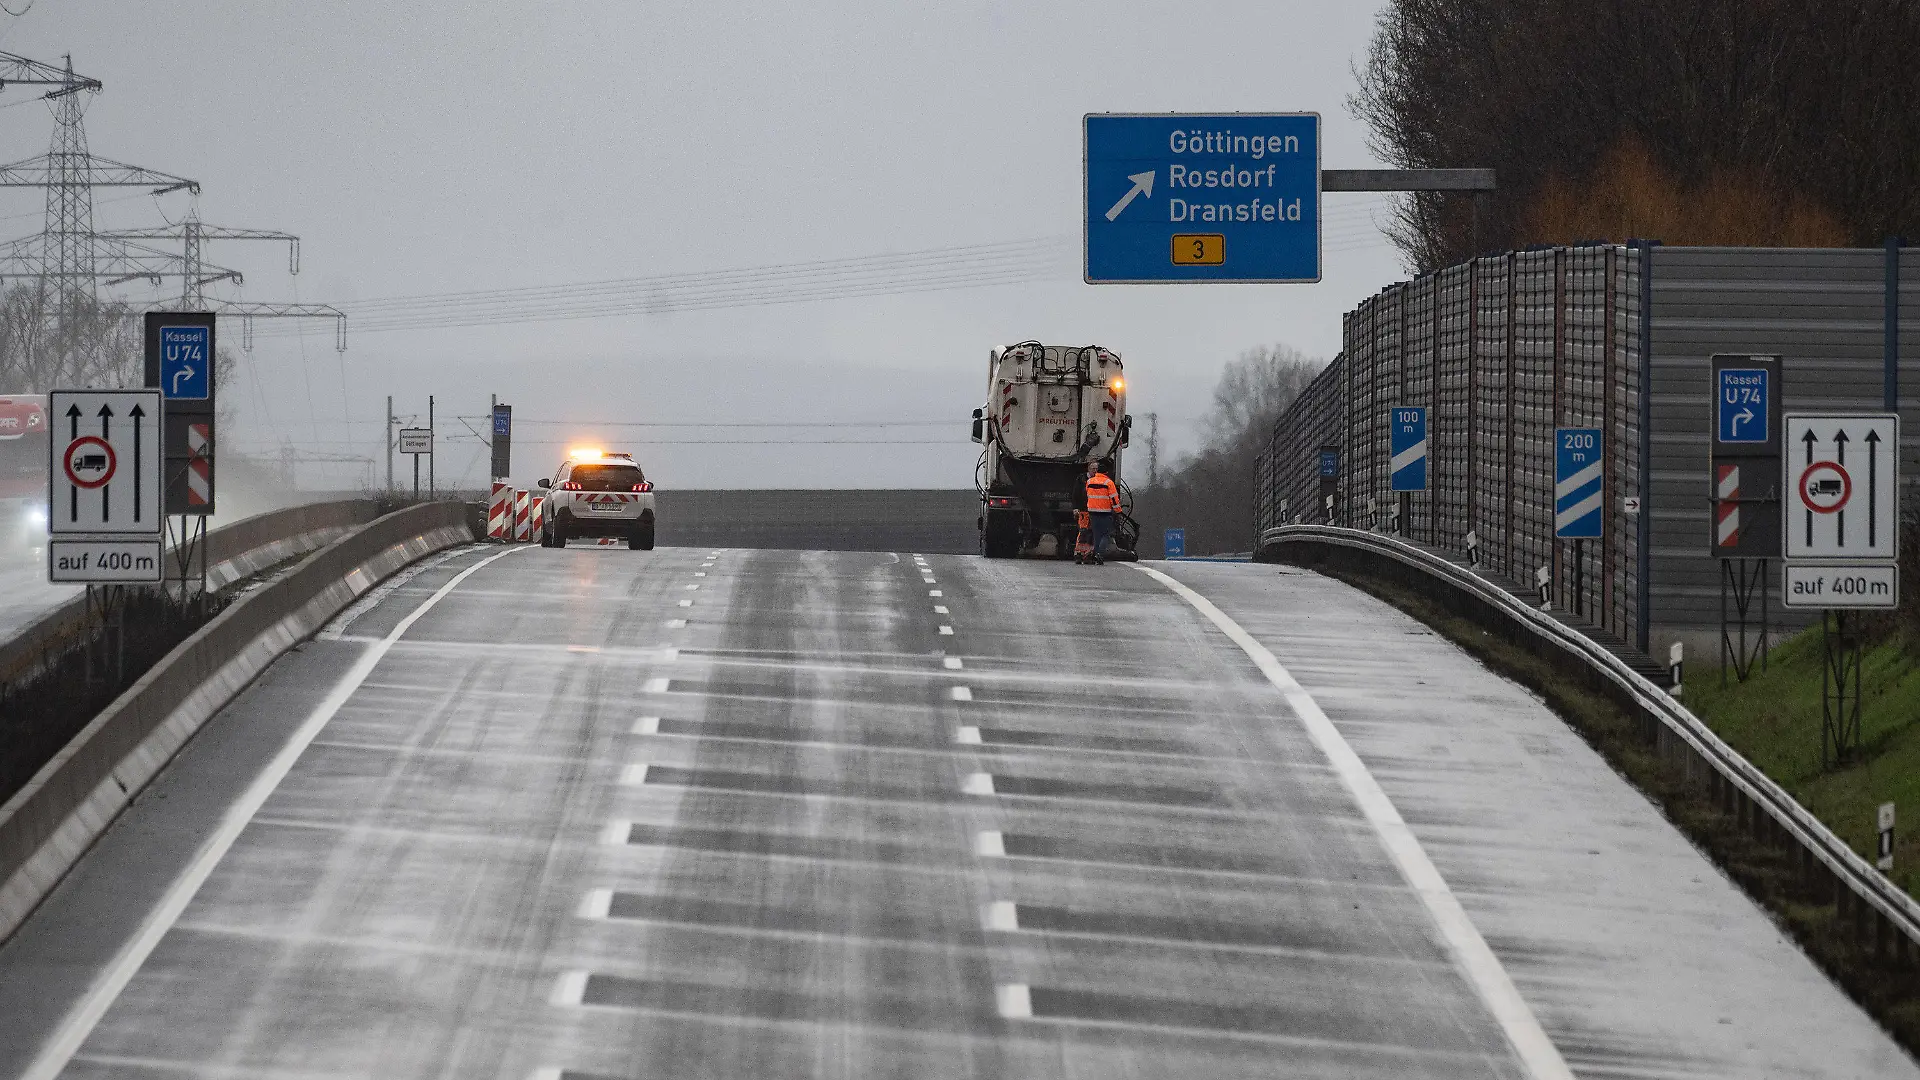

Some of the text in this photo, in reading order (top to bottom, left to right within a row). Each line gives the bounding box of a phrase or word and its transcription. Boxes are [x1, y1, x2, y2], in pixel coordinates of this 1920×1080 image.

[1170, 130, 1299, 160] Göttingen
[1170, 164, 1276, 188] Rosdorf
[1170, 198, 1301, 222] Dransfeld
[1192, 240, 1205, 260] 3
[165, 332, 203, 342] Kassel
[1725, 374, 1762, 385] Kassel
[1398, 411, 1419, 423] 100
[1403, 425, 1413, 433] m
[1564, 434, 1593, 449] 200
[1572, 453, 1585, 463] m
[58, 552, 88, 570] auf
[1793, 577, 1824, 596] auf
